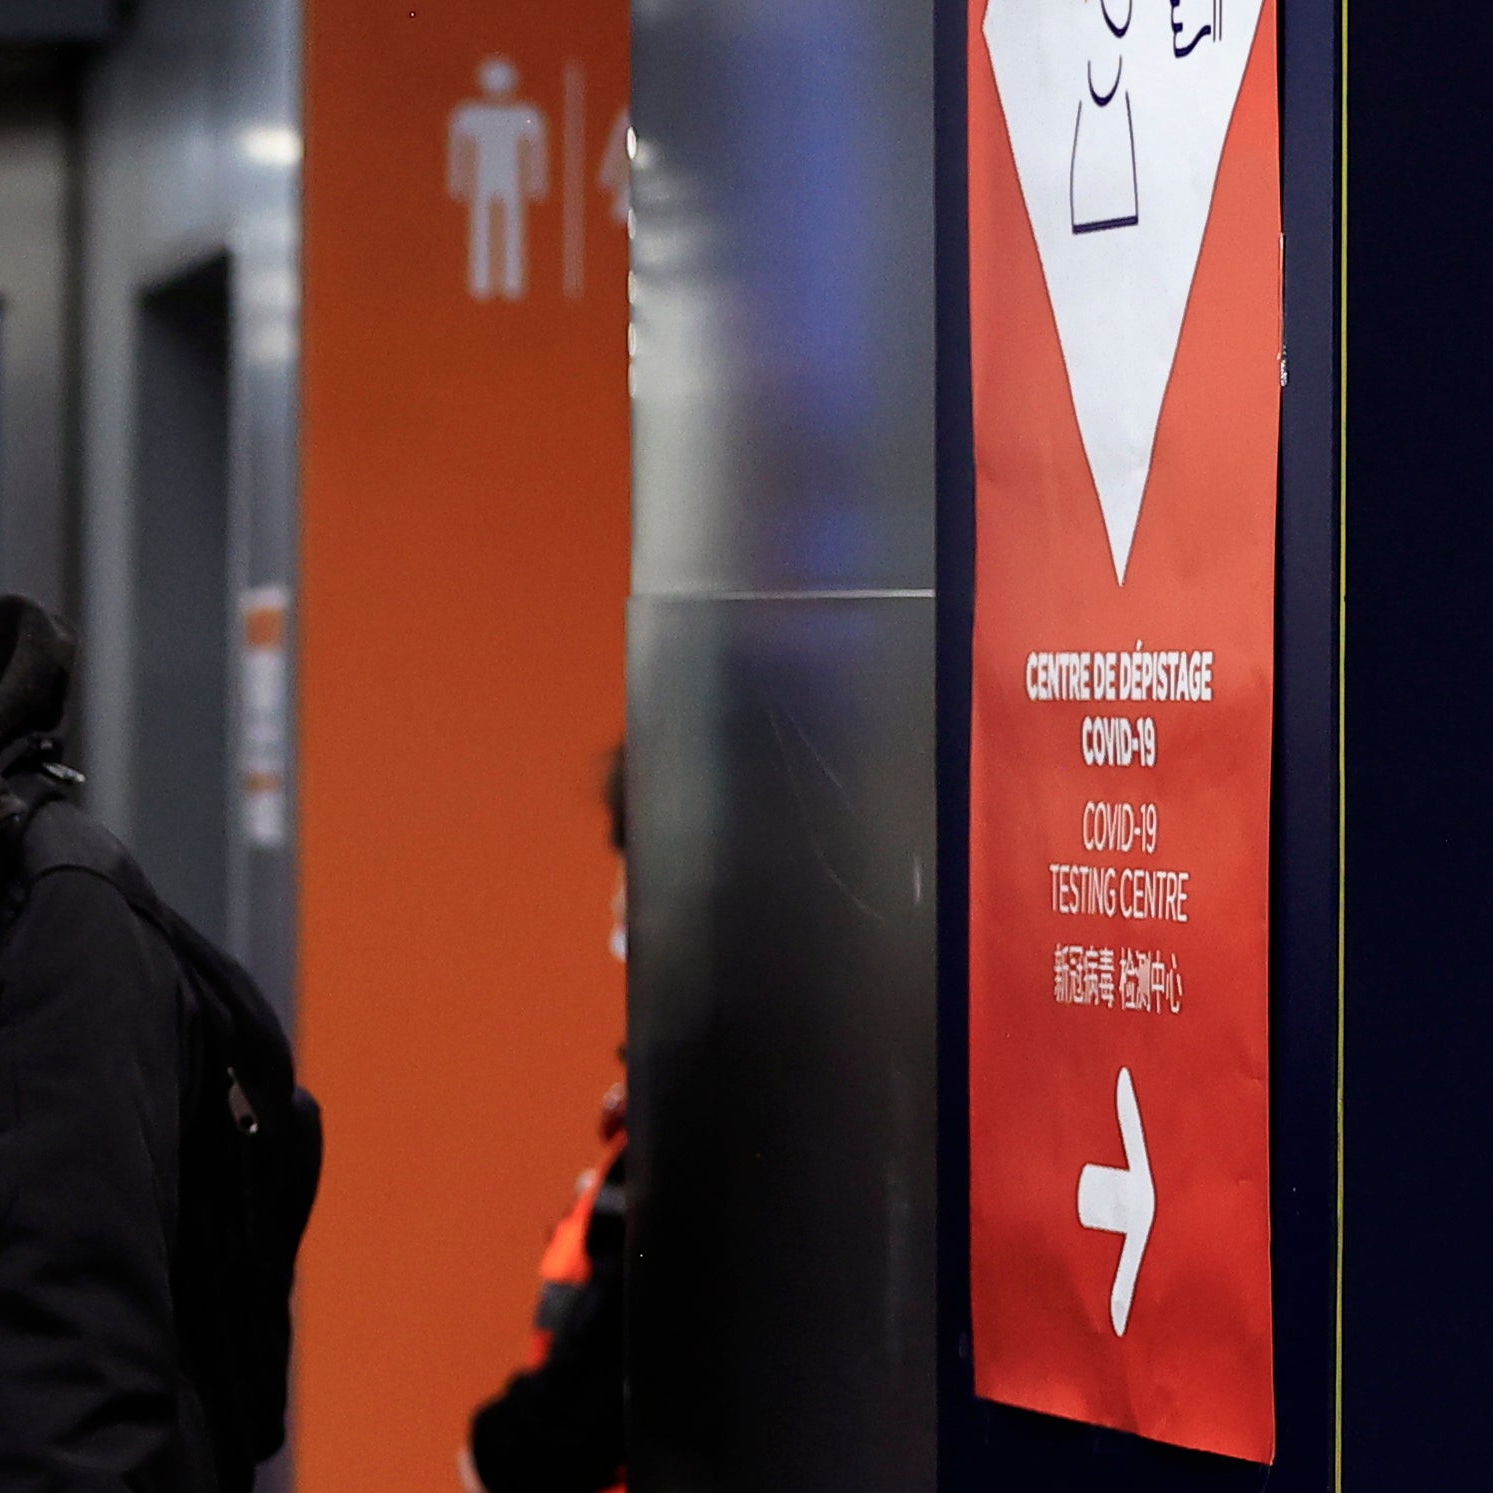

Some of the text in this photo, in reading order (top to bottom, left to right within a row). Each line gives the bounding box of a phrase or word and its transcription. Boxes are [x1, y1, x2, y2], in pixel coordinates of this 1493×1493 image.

[1026, 639, 1214, 702] CENTRE DE DÉPISTAGE
[1081, 715, 1157, 768] COVID-19
[1082, 800, 1158, 854] COVID-19
[1049, 863, 1189, 922] TESTING CENTRE
